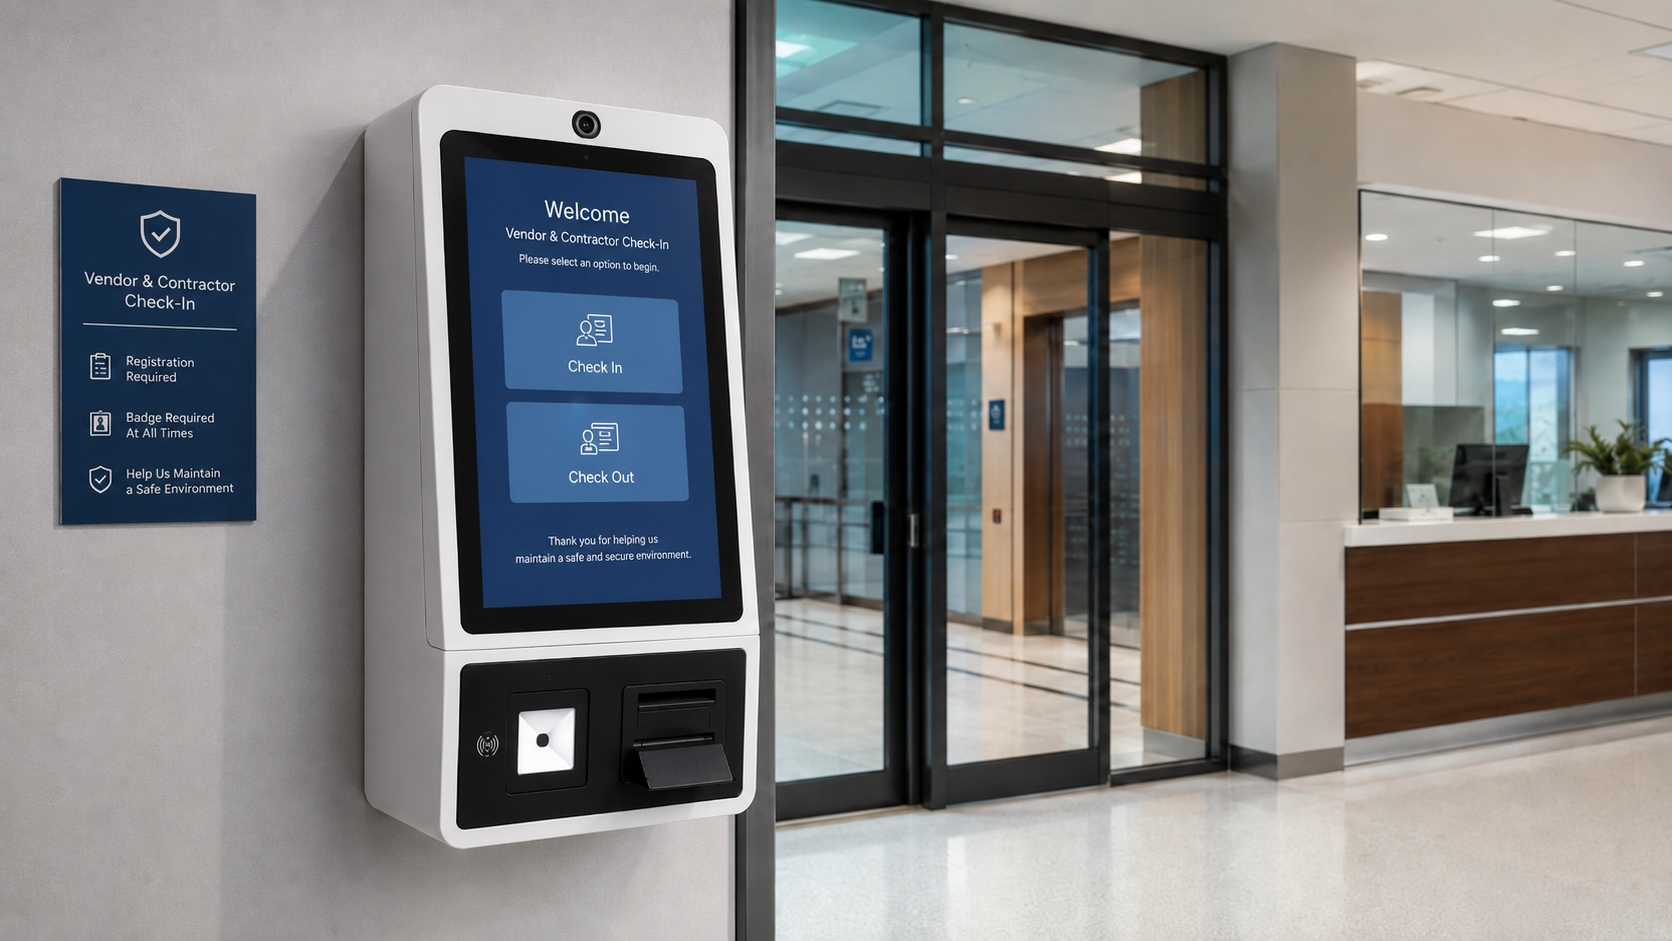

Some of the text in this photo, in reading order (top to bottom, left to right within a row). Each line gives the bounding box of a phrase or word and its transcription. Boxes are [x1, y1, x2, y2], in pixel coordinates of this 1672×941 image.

[545, 200, 630, 225] Welcome
[506, 227, 669, 250] Vendor & Contractor Check-In
[519, 253, 660, 274] Please select an option to begin.
[84, 272, 236, 292] Vendor & Contractor
[125, 294, 195, 311] Check-In
[127, 356, 195, 370] Registration
[568, 360, 623, 374] Check In
[127, 371, 177, 385] Required
[127, 412, 215, 426] Badge Required
[125, 427, 194, 439] At All Times
[127, 467, 221, 482] Help Us Maintain
[568, 470, 635, 484] Check Out
[125, 482, 234, 495] a Safe Environment
[547, 534, 659, 548] Thank you for helping us
[515, 549, 692, 564] maintain a safe and secure environment.
